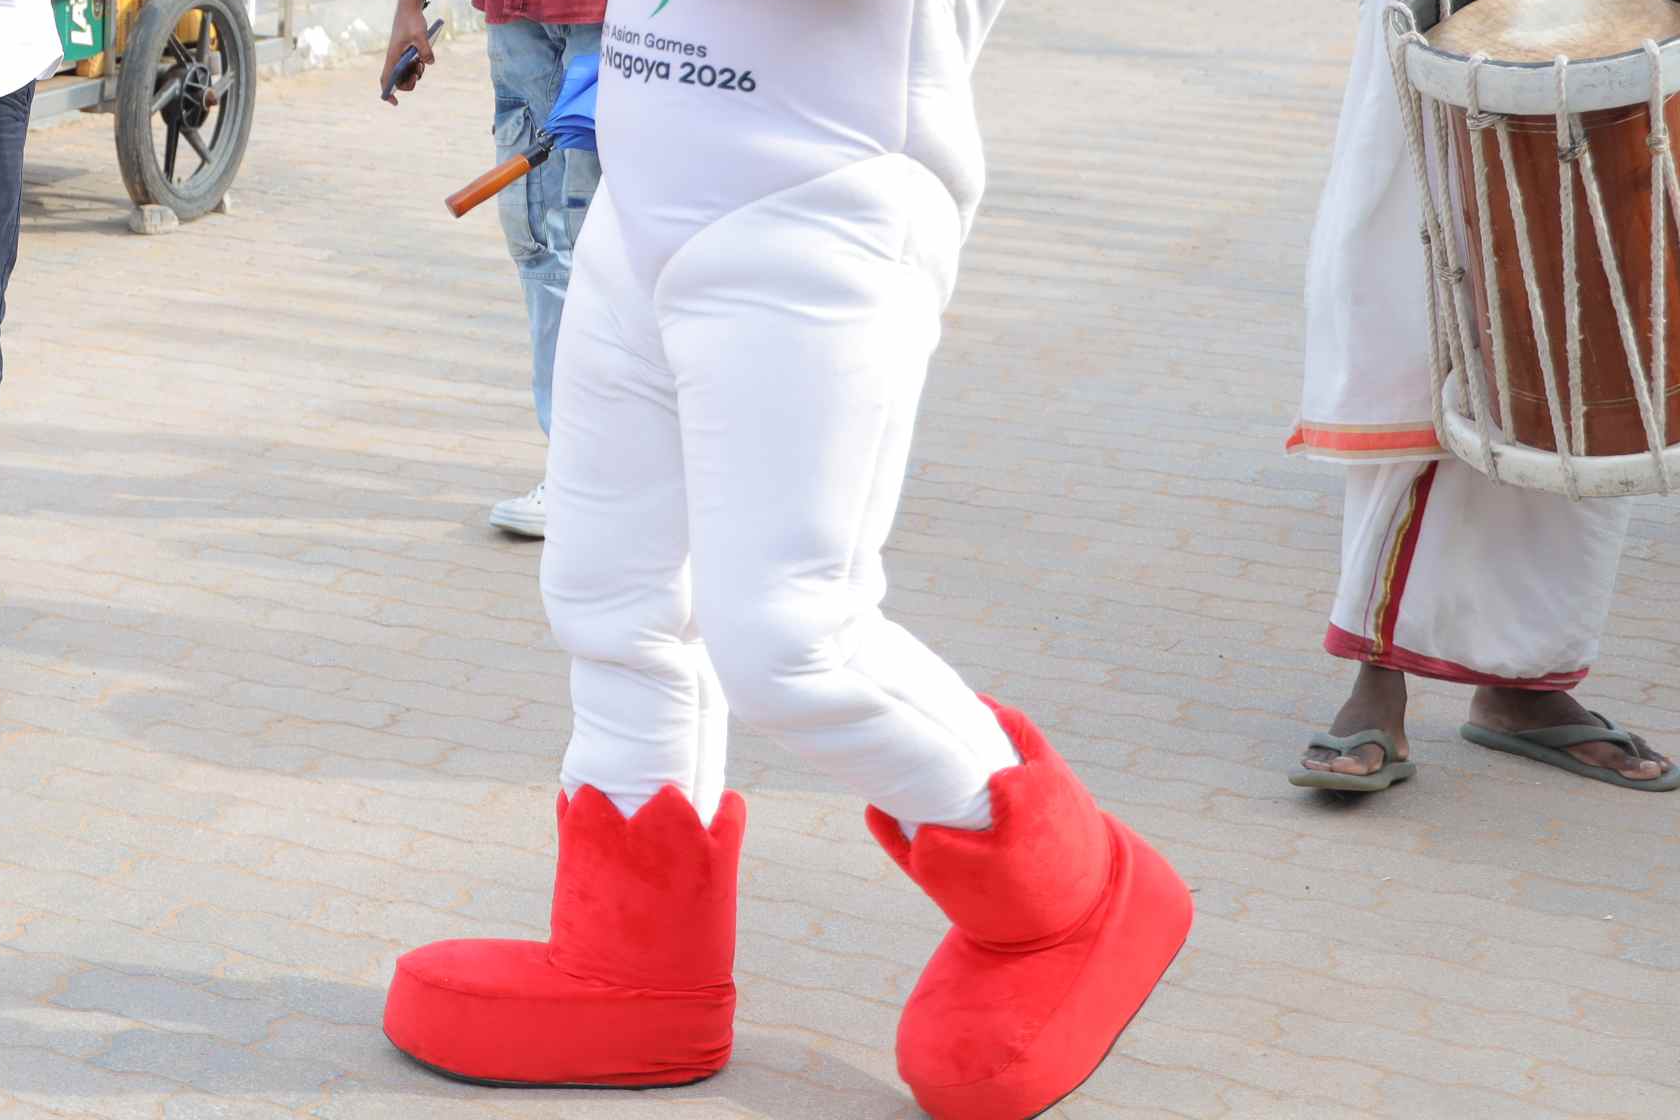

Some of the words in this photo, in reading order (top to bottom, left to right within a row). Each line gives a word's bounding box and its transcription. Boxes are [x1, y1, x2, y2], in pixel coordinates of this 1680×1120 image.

[611, 24, 640, 46] Asian
[644, 33, 707, 58] Games
[679, 61, 756, 92] 2026
